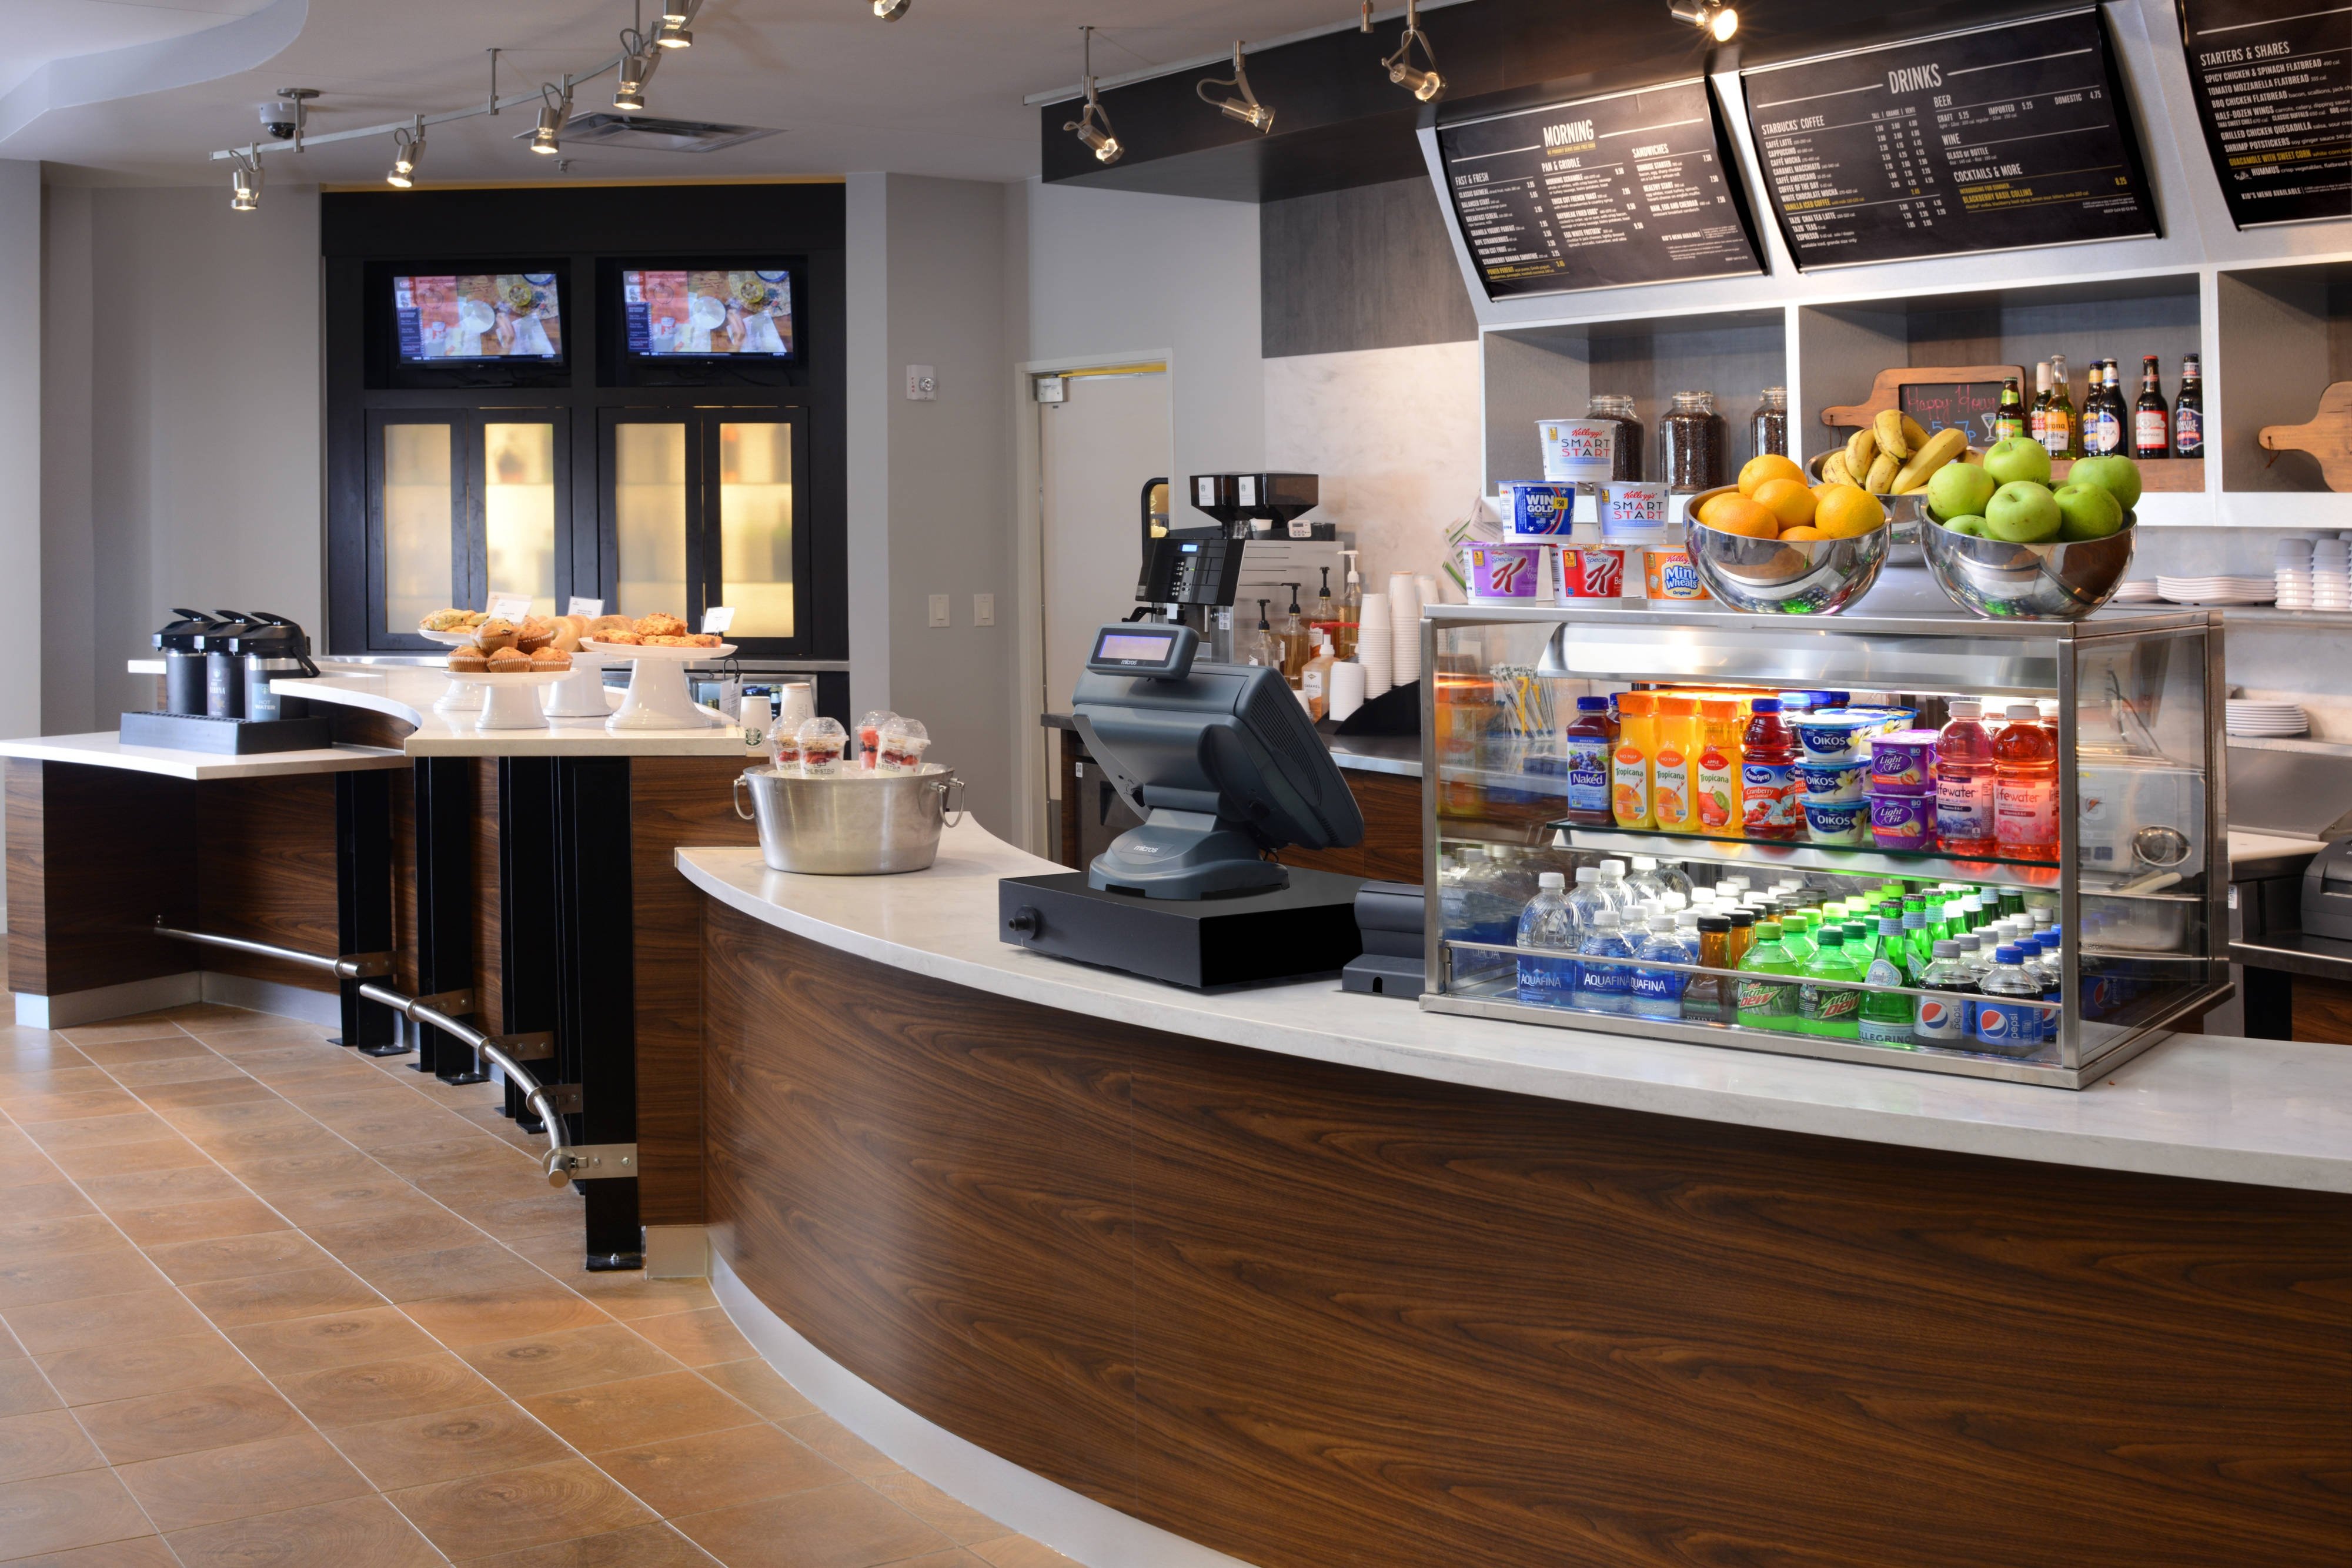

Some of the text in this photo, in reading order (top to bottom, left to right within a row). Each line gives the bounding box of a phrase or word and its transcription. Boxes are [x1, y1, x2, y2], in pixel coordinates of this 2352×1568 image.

[2200, 41, 2290, 66] STARTERS & SHARES
[2205, 59, 2321, 83] SPICY CHICKEN & SPINACH FLATBREAD
[1888, 63, 1942, 94] DRINKS
[2208, 74, 2309, 96] TOMATO MOZZARELLA FLATBREAD
[1933, 95, 1952, 108] BEER
[2054, 90, 2102, 105] DOMESTIC 4.75
[2211, 91, 2287, 108] BBQ CHICKEN FLATBREAD
[1988, 101, 2033, 115] IMPORTED 5.25
[2214, 109, 2252, 121] HALF-DOZEN
[2253, 105, 2274, 115] WINGS
[1800, 115, 1825, 129] COFFEE
[1937, 111, 1969, 123] CRAFT 5.25
[1543, 119, 1595, 147] MORNING
[2220, 122, 2312, 141] GRILLED CHICKEN QUESADILLA
[1780, 138, 1792, 146] LATTE
[1942, 133, 1961, 146] WINE
[2224, 142, 2248, 153] SHRIMP
[2249, 138, 2290, 150] POTSTICKERS
[1632, 143, 1669, 158] SANDWICHES
[1768, 147, 1796, 158] CAPPUCCINO
[1946, 151, 1963, 160] GLASS
[1970, 147, 1989, 156] BOTTLE
[1784, 156, 1801, 165] MOCHA
[2229, 149, 2311, 166] GUACAMOLE WITH SWEET CORN
[1541, 157, 1581, 172] PAN & GRIDDLE
[1773, 162, 1821, 176] CARAMEL MACCHIATO
[2251, 166, 2280, 176] HUMMUS
[1455, 176, 1468, 186] FAST
[1473, 172, 1489, 183] FRESH
[1790, 173, 1816, 182] AMERICANO
[1953, 163, 2023, 182] COCKTAILS & MORE
[1795, 191, 1821, 200] CHOCOLATE
[1822, 188, 1839, 197] MOCHA
[1962, 193, 1994, 203] BLACKBERRY
[1995, 190, 2010, 200] BASIL
[2010, 188, 2033, 198] COLLINS
[2257, 190, 2273, 198] MENU
[2273, 187, 2301, 196] AVAILABLE
[1783, 202, 1803, 211] VANILLA
[1814, 198, 1831, 207] COFFEE
[1822, 212, 1836, 220] LATTE
[1905, 385, 1998, 424] Happy Hour
[1572, 427, 1603, 438] Kellogg's
[1562, 439, 1610, 447] SMART
[1562, 448, 1611, 457] START
[1526, 494, 1554, 505] WIN
[1623, 490, 1655, 501] Kellogg's
[1613, 502, 1663, 510] SMART
[1614, 511, 1664, 520] START
[1666, 578, 1697, 590] Wheats
[1812, 737, 1846, 745] OIKOS
[1880, 755, 1903, 765] Light
[1573, 773, 1603, 784] Naked
[1616, 768, 1643, 777] Tropicana
[1657, 770, 1685, 780] Tropicana
[1700, 774, 1729, 784] Tropicana
[1746, 771, 1770, 782] Ocean Spray
[1806, 776, 1835, 785] OIKOS
[1937, 783, 1976, 798] ifewater
[1996, 788, 2040, 803] lifewater
[1880, 807, 1903, 817] Light
[1817, 815, 1850, 825] OIKOS
[1521, 974, 1561, 988] AQUAFINA
[1584, 973, 1629, 987] AQUAFINA
[1631, 977, 1666, 992] QUAFINA
[1952, 1005, 1962, 1029] pepsi
[2009, 1013, 2019, 1039] pepsi
